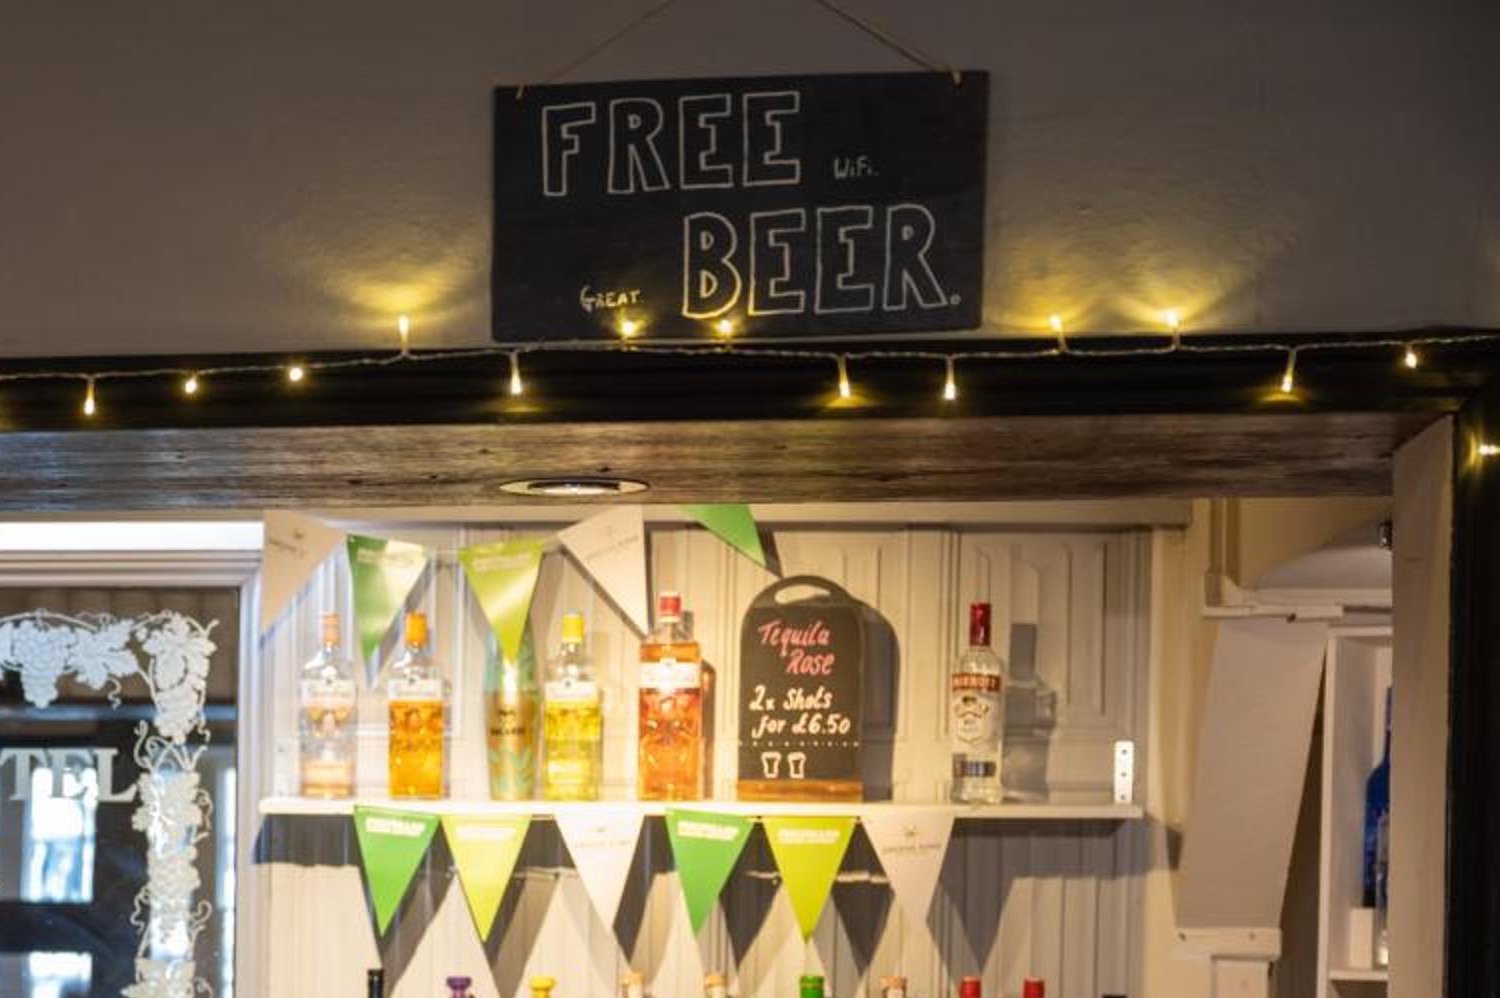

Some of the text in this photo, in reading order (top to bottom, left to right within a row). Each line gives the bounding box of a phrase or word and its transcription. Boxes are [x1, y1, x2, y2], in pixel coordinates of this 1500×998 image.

[542, 90, 801, 196] FREE
[758, 618, 831, 657] Tequila
[785, 650, 835, 677] Rose
[753, 711, 851, 739] for £6.50
